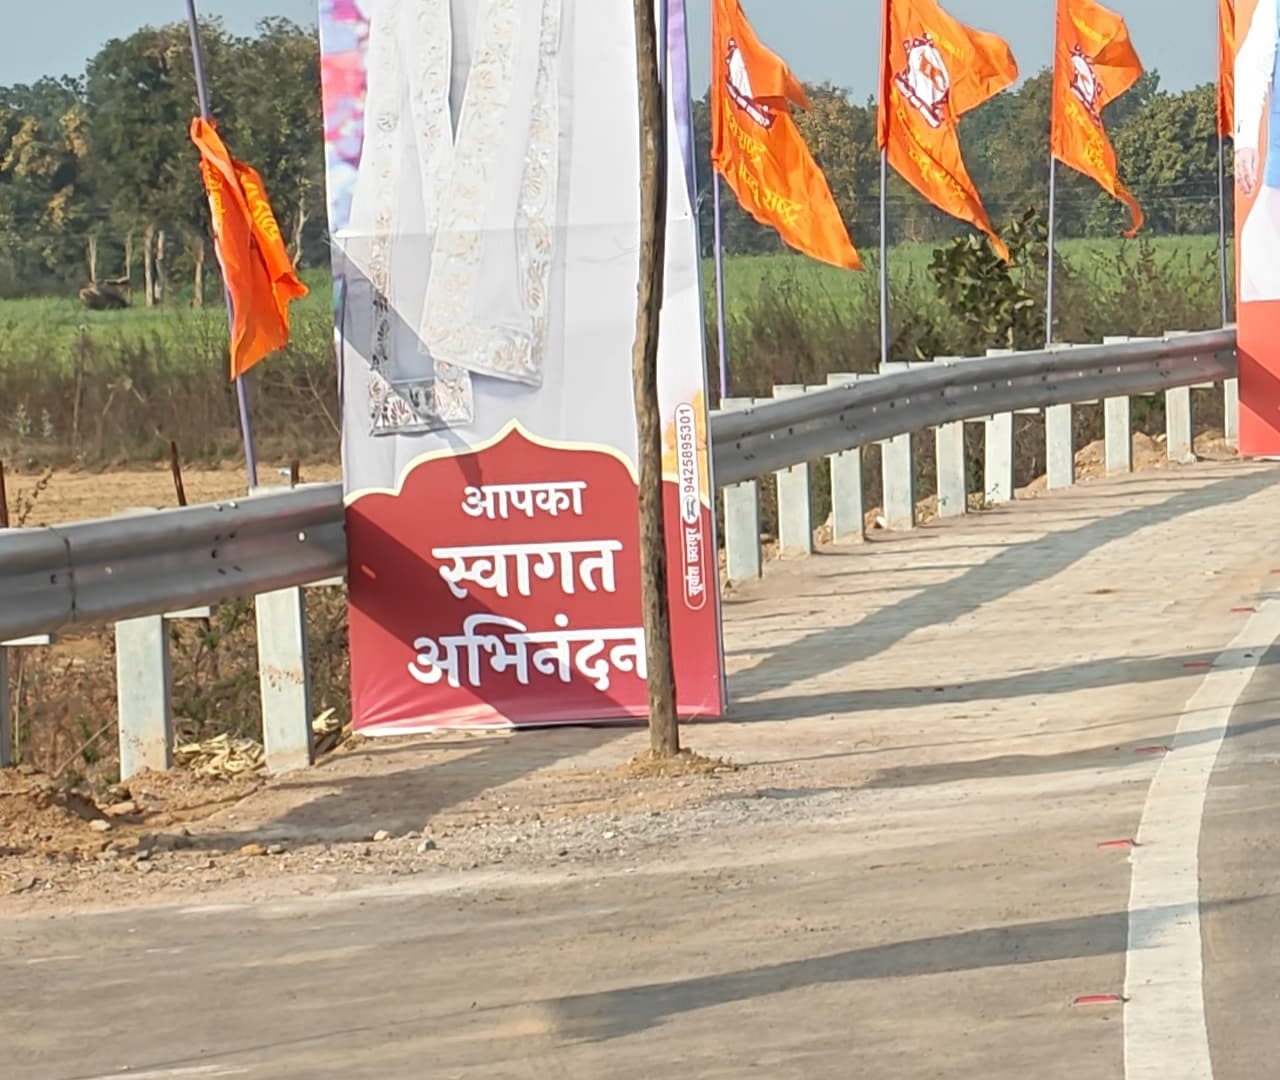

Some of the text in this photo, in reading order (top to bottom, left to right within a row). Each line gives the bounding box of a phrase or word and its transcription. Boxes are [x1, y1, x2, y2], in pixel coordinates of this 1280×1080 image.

[679, 408, 696, 493] 9425895301
[461, 480, 587, 519] आपका
[431, 539, 623, 599] स्वागत
[407, 612, 648, 691] अभिनंदन
